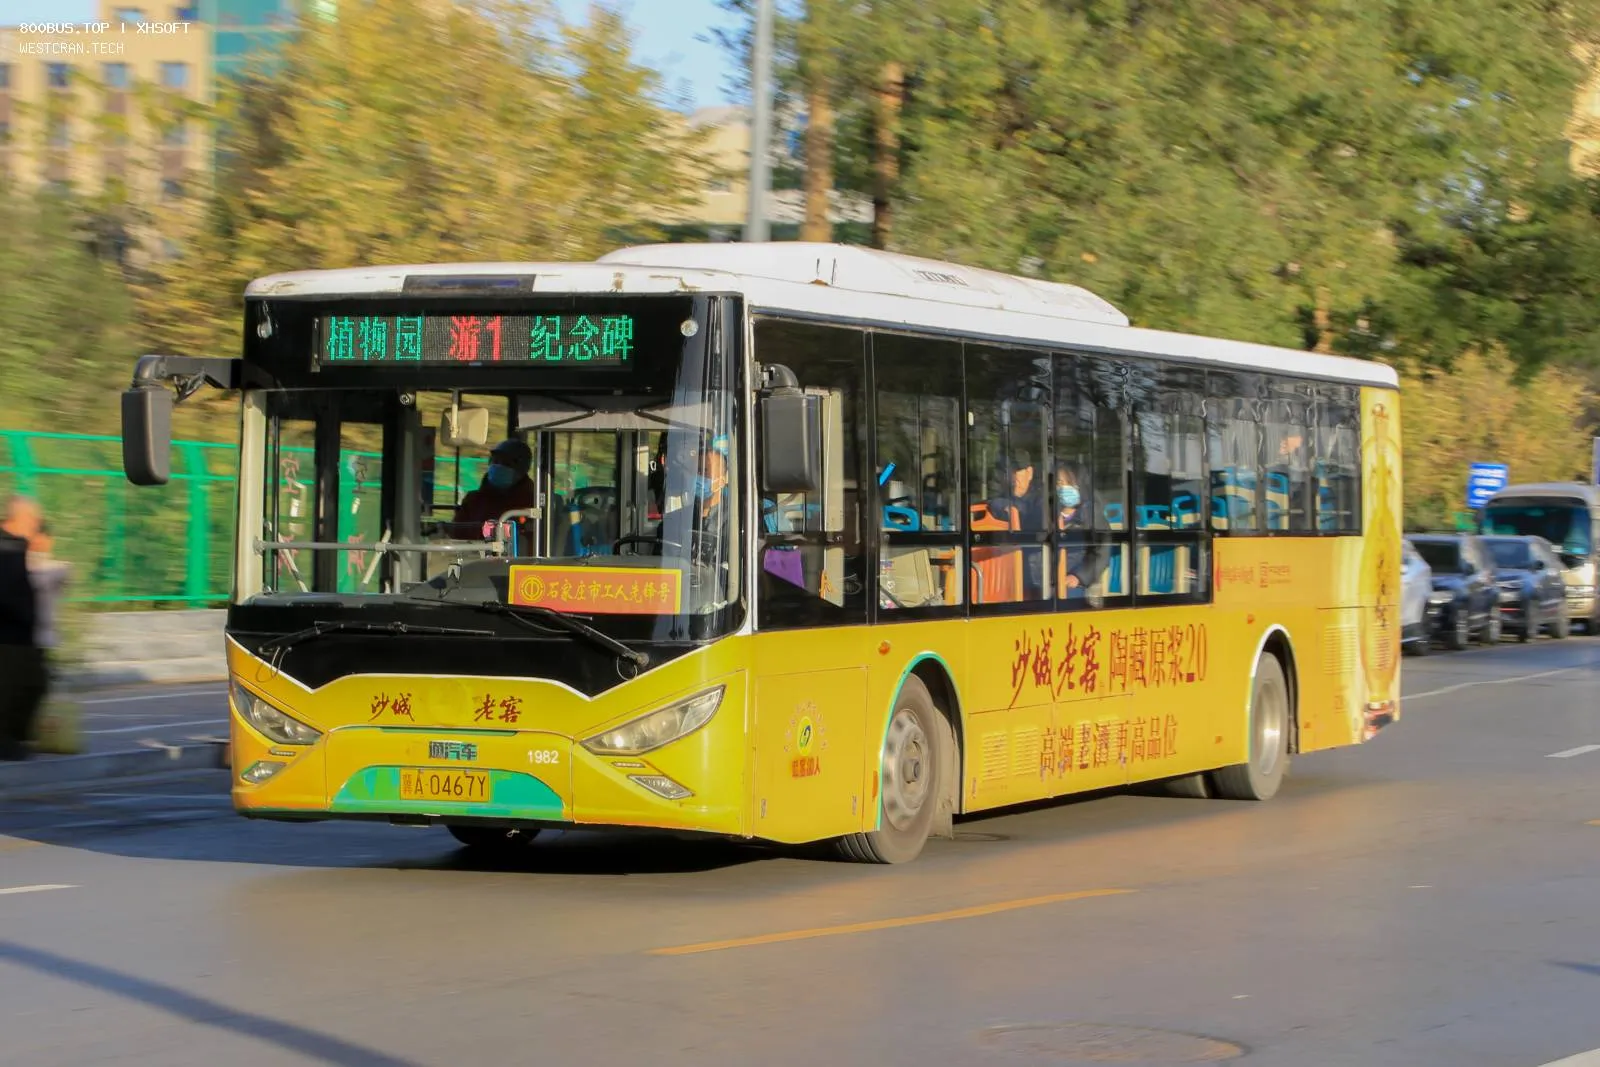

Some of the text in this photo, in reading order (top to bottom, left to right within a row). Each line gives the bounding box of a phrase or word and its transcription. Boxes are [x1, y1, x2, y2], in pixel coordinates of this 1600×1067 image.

[326, 314, 635, 361] 植物园 游1 纪念碑
[546, 578, 671, 604] 石家庄市工人先锋号
[527, 750, 560, 764] 1982
